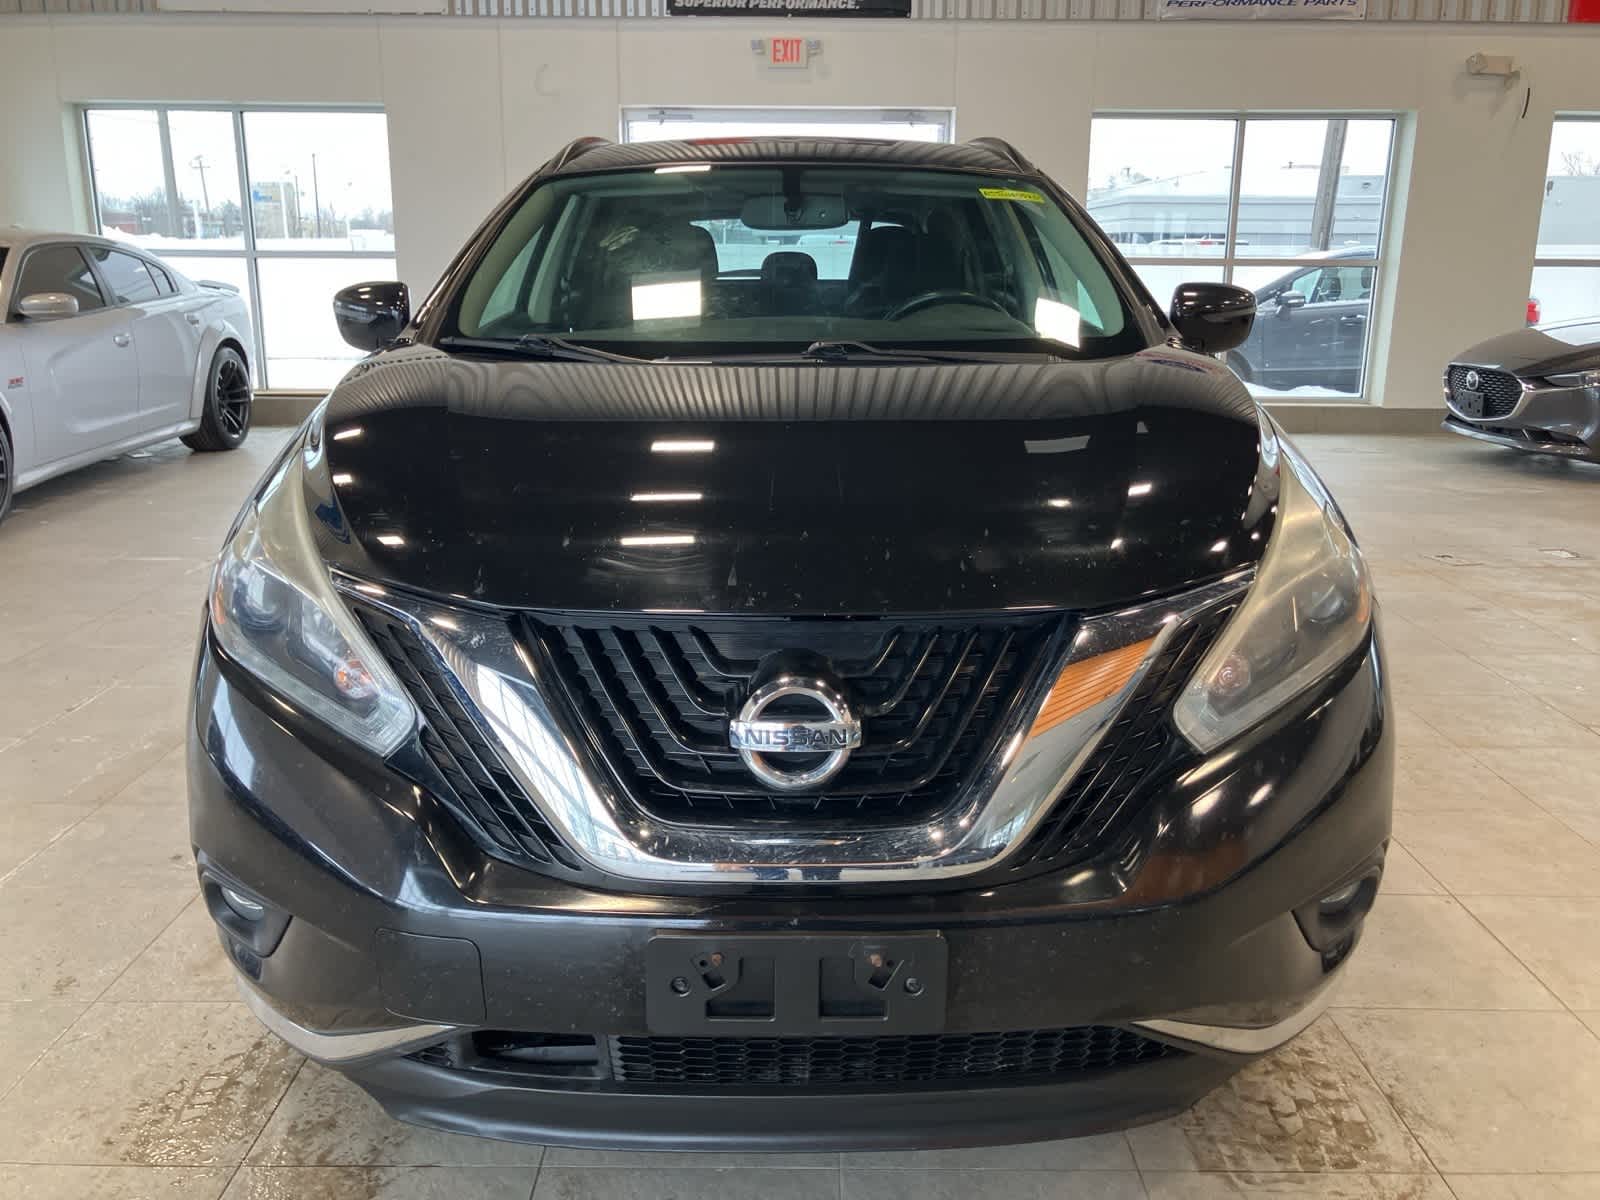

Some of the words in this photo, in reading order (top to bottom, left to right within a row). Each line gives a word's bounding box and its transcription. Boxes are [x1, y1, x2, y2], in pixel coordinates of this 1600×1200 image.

[674, 0, 746, 8] SUPERIOR
[772, 39, 802, 64] EXIT
[744, 729, 848, 746] NISSAN
